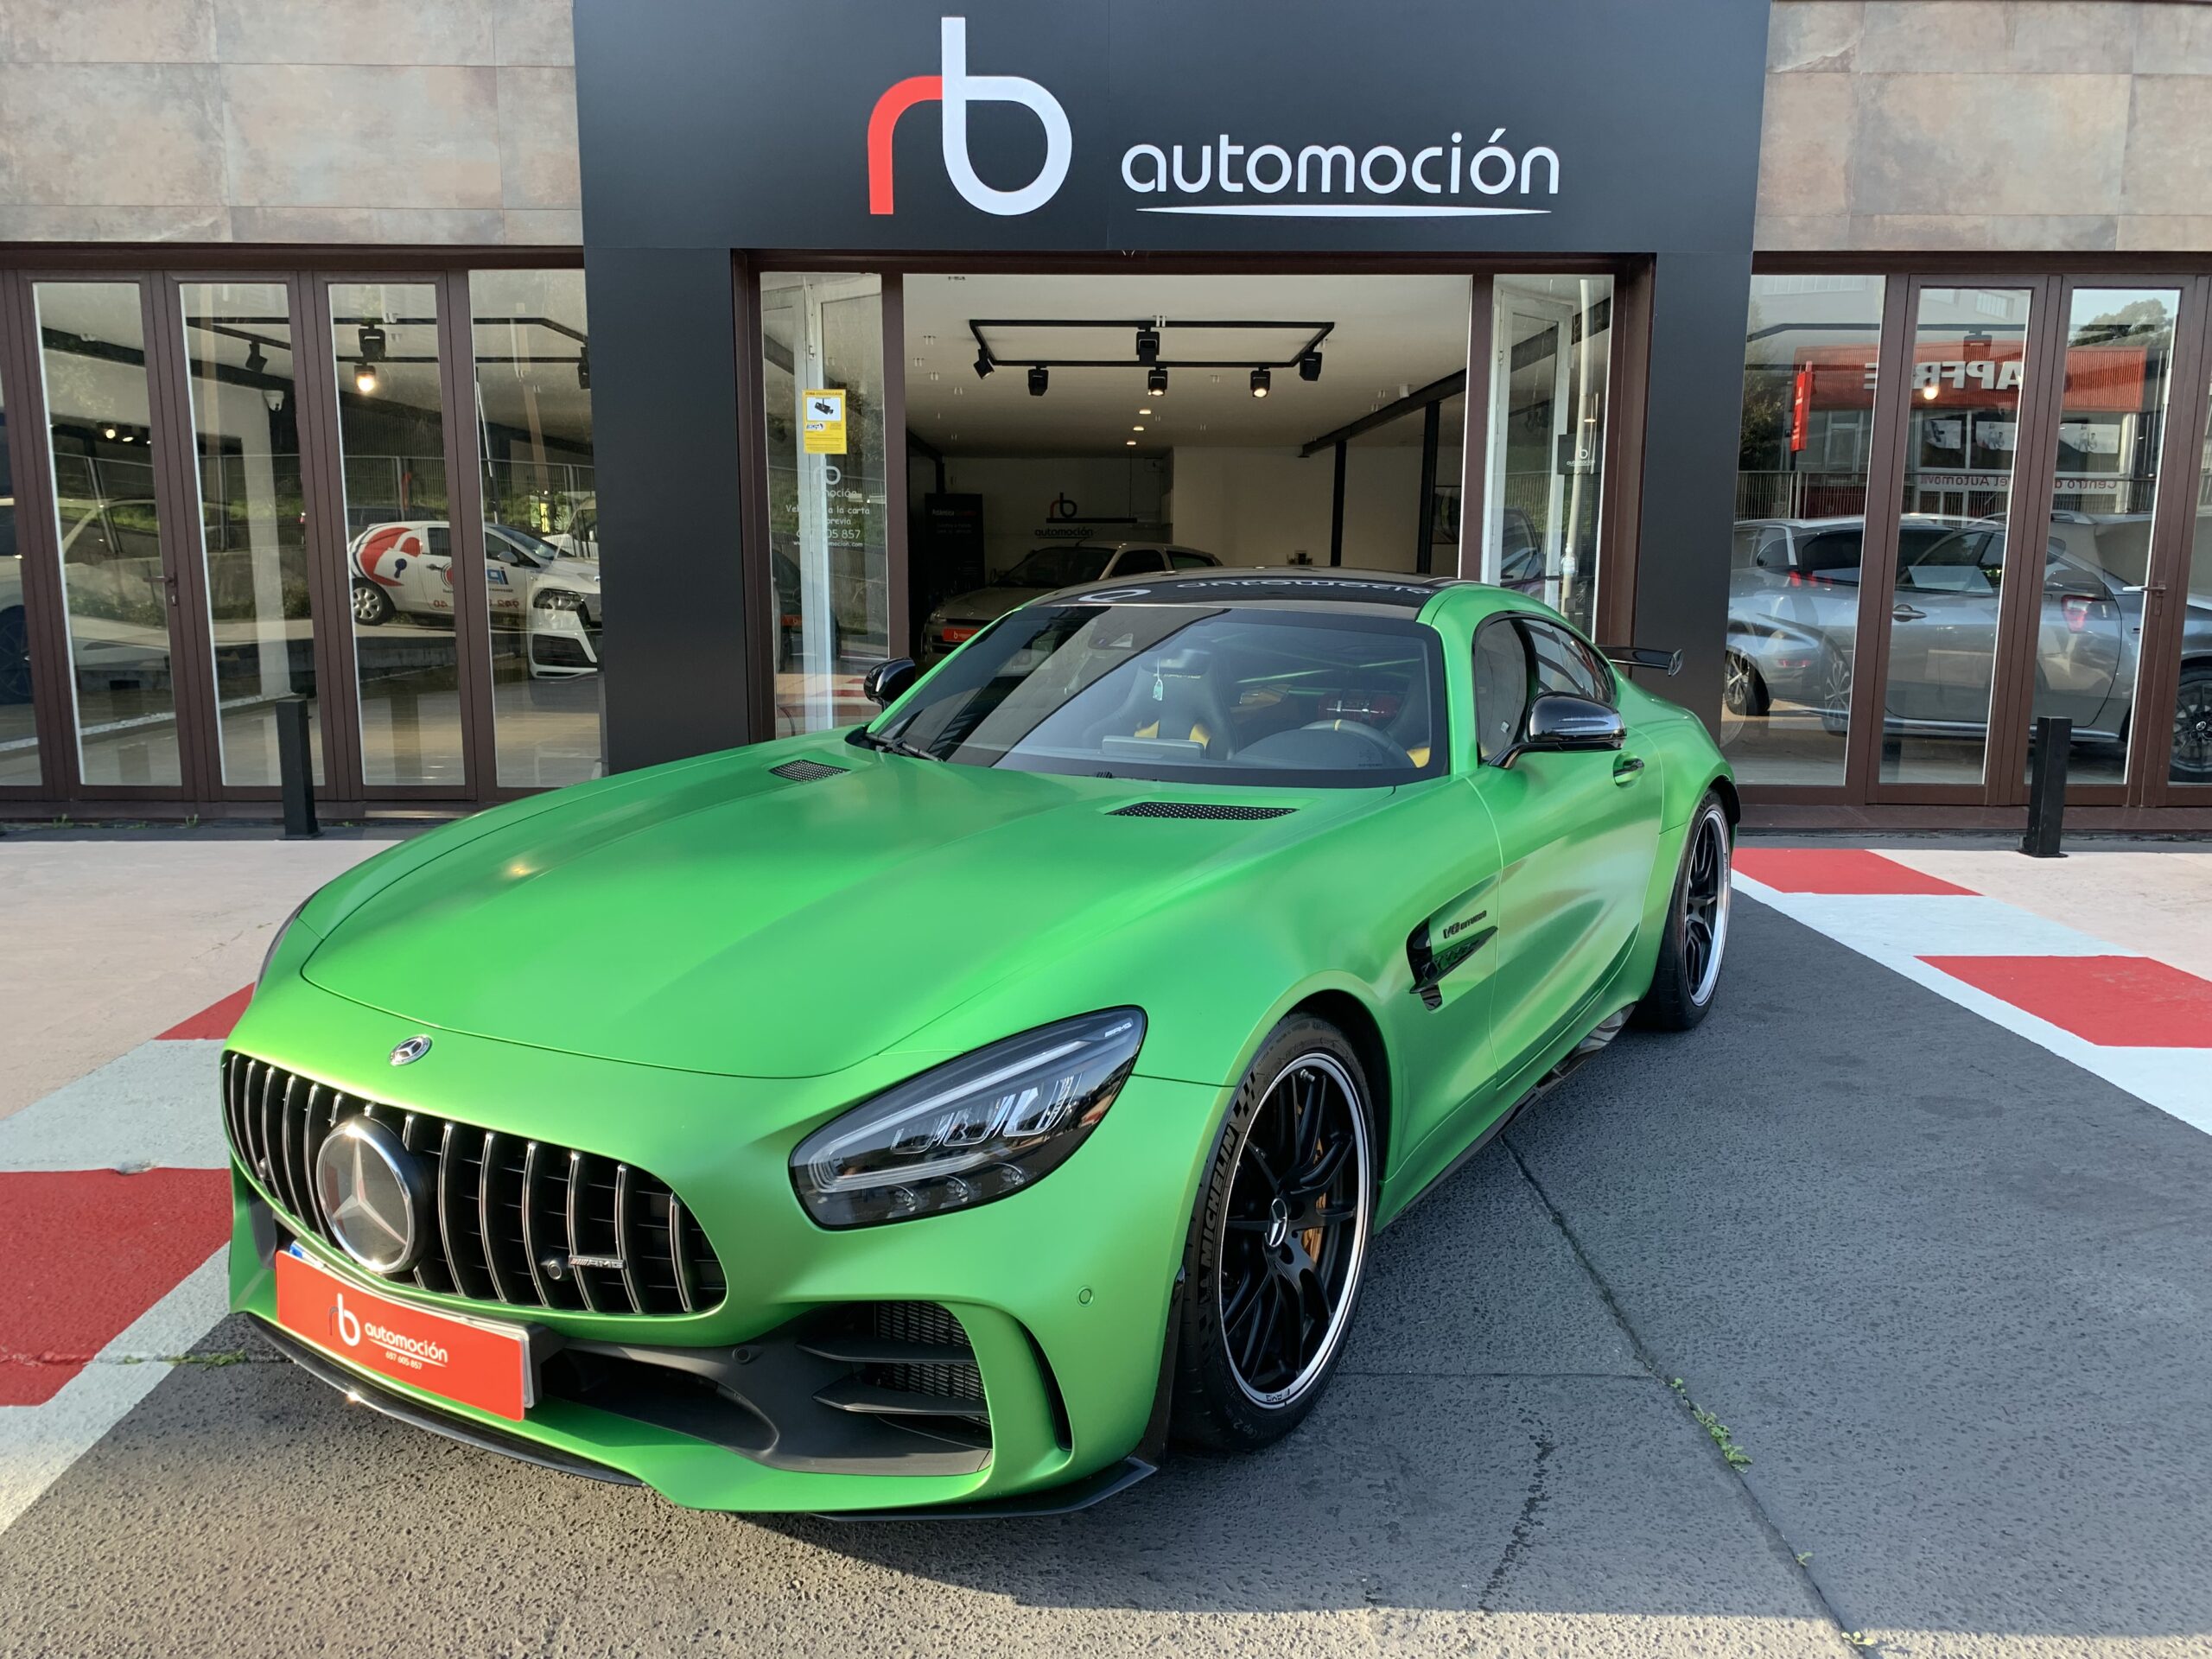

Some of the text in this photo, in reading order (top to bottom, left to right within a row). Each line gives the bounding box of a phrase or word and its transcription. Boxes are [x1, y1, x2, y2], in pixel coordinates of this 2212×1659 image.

[868, 16, 1072, 215] rb
[1122, 128, 1559, 194] automoción
[842, 529, 861, 539] 857
[848, 506, 870, 515] carta
[1200, 1123, 1240, 1268] MICHELIN
[365, 1322, 448, 1363] automoción
